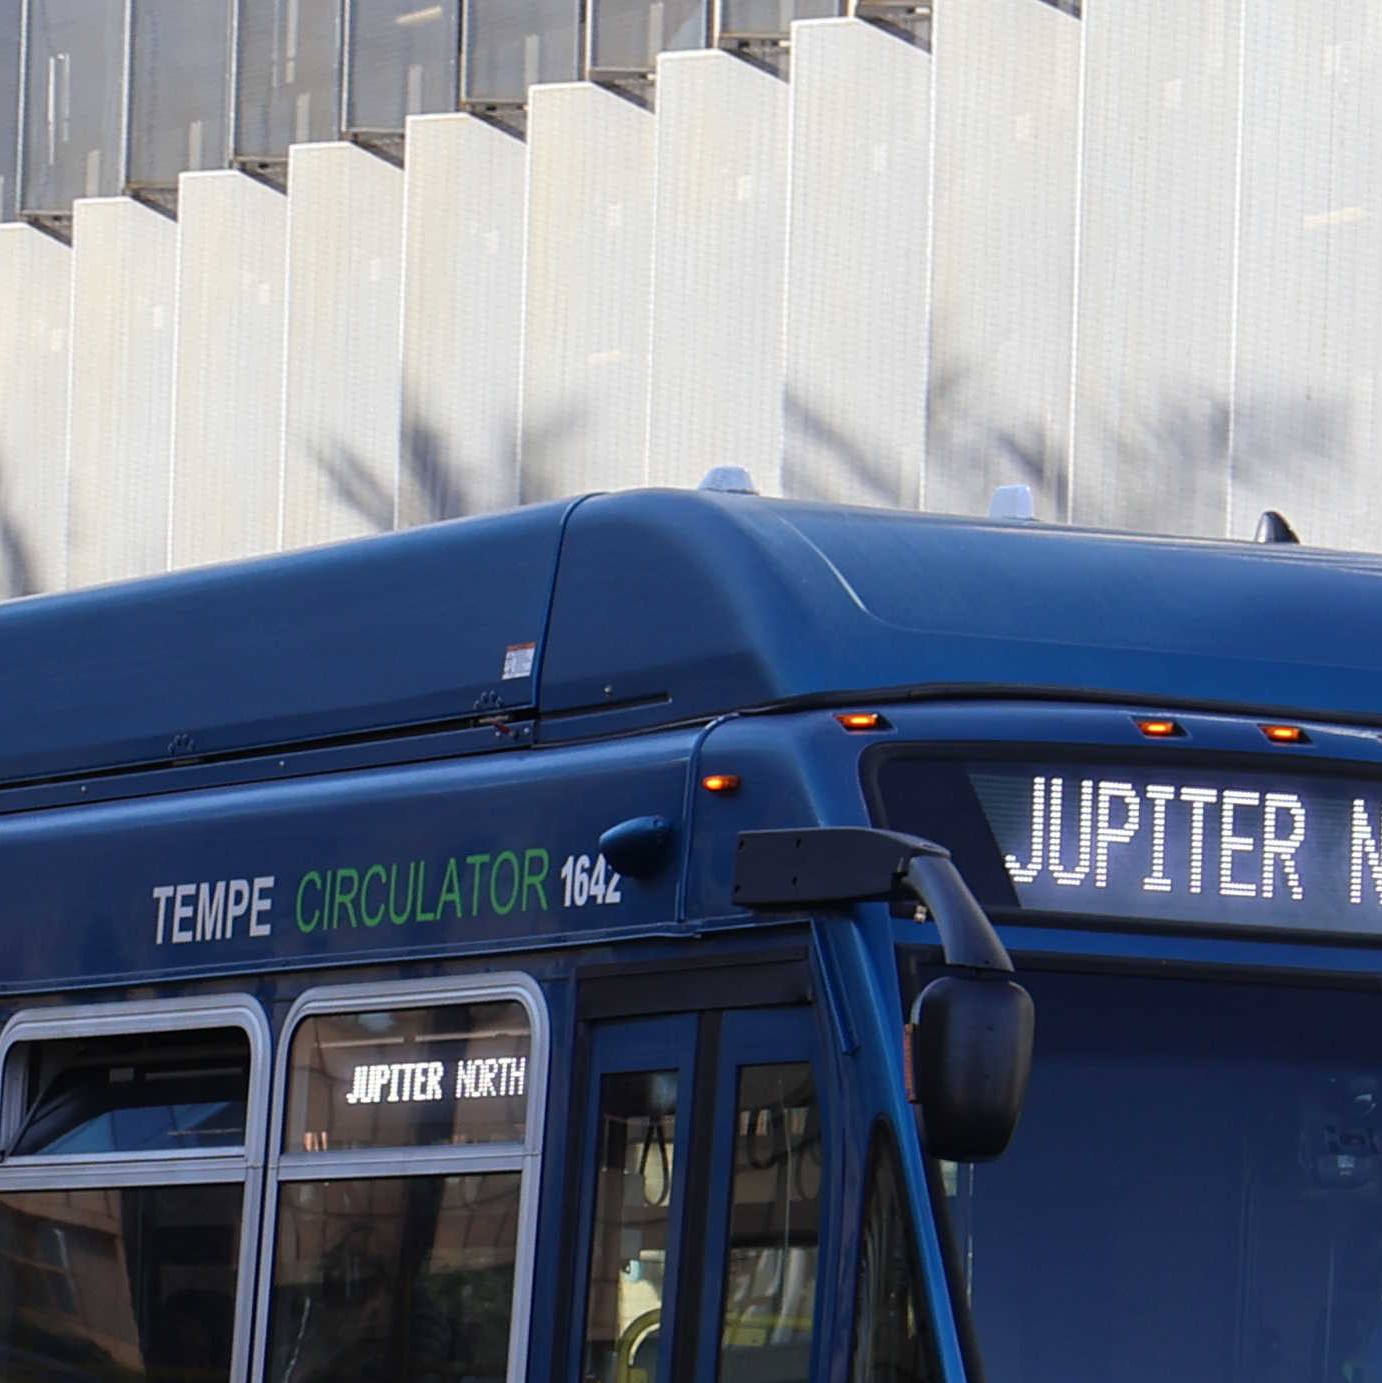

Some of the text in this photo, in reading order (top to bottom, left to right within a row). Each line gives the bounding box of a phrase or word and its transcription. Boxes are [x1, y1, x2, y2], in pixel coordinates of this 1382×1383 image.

[1003, 776, 1307, 900] JUPITER
[152, 876, 275, 945] TEMPE
[295, 847, 550, 934] CIRCULATOR
[345, 1056, 527, 1104] JUPITER NORTH
